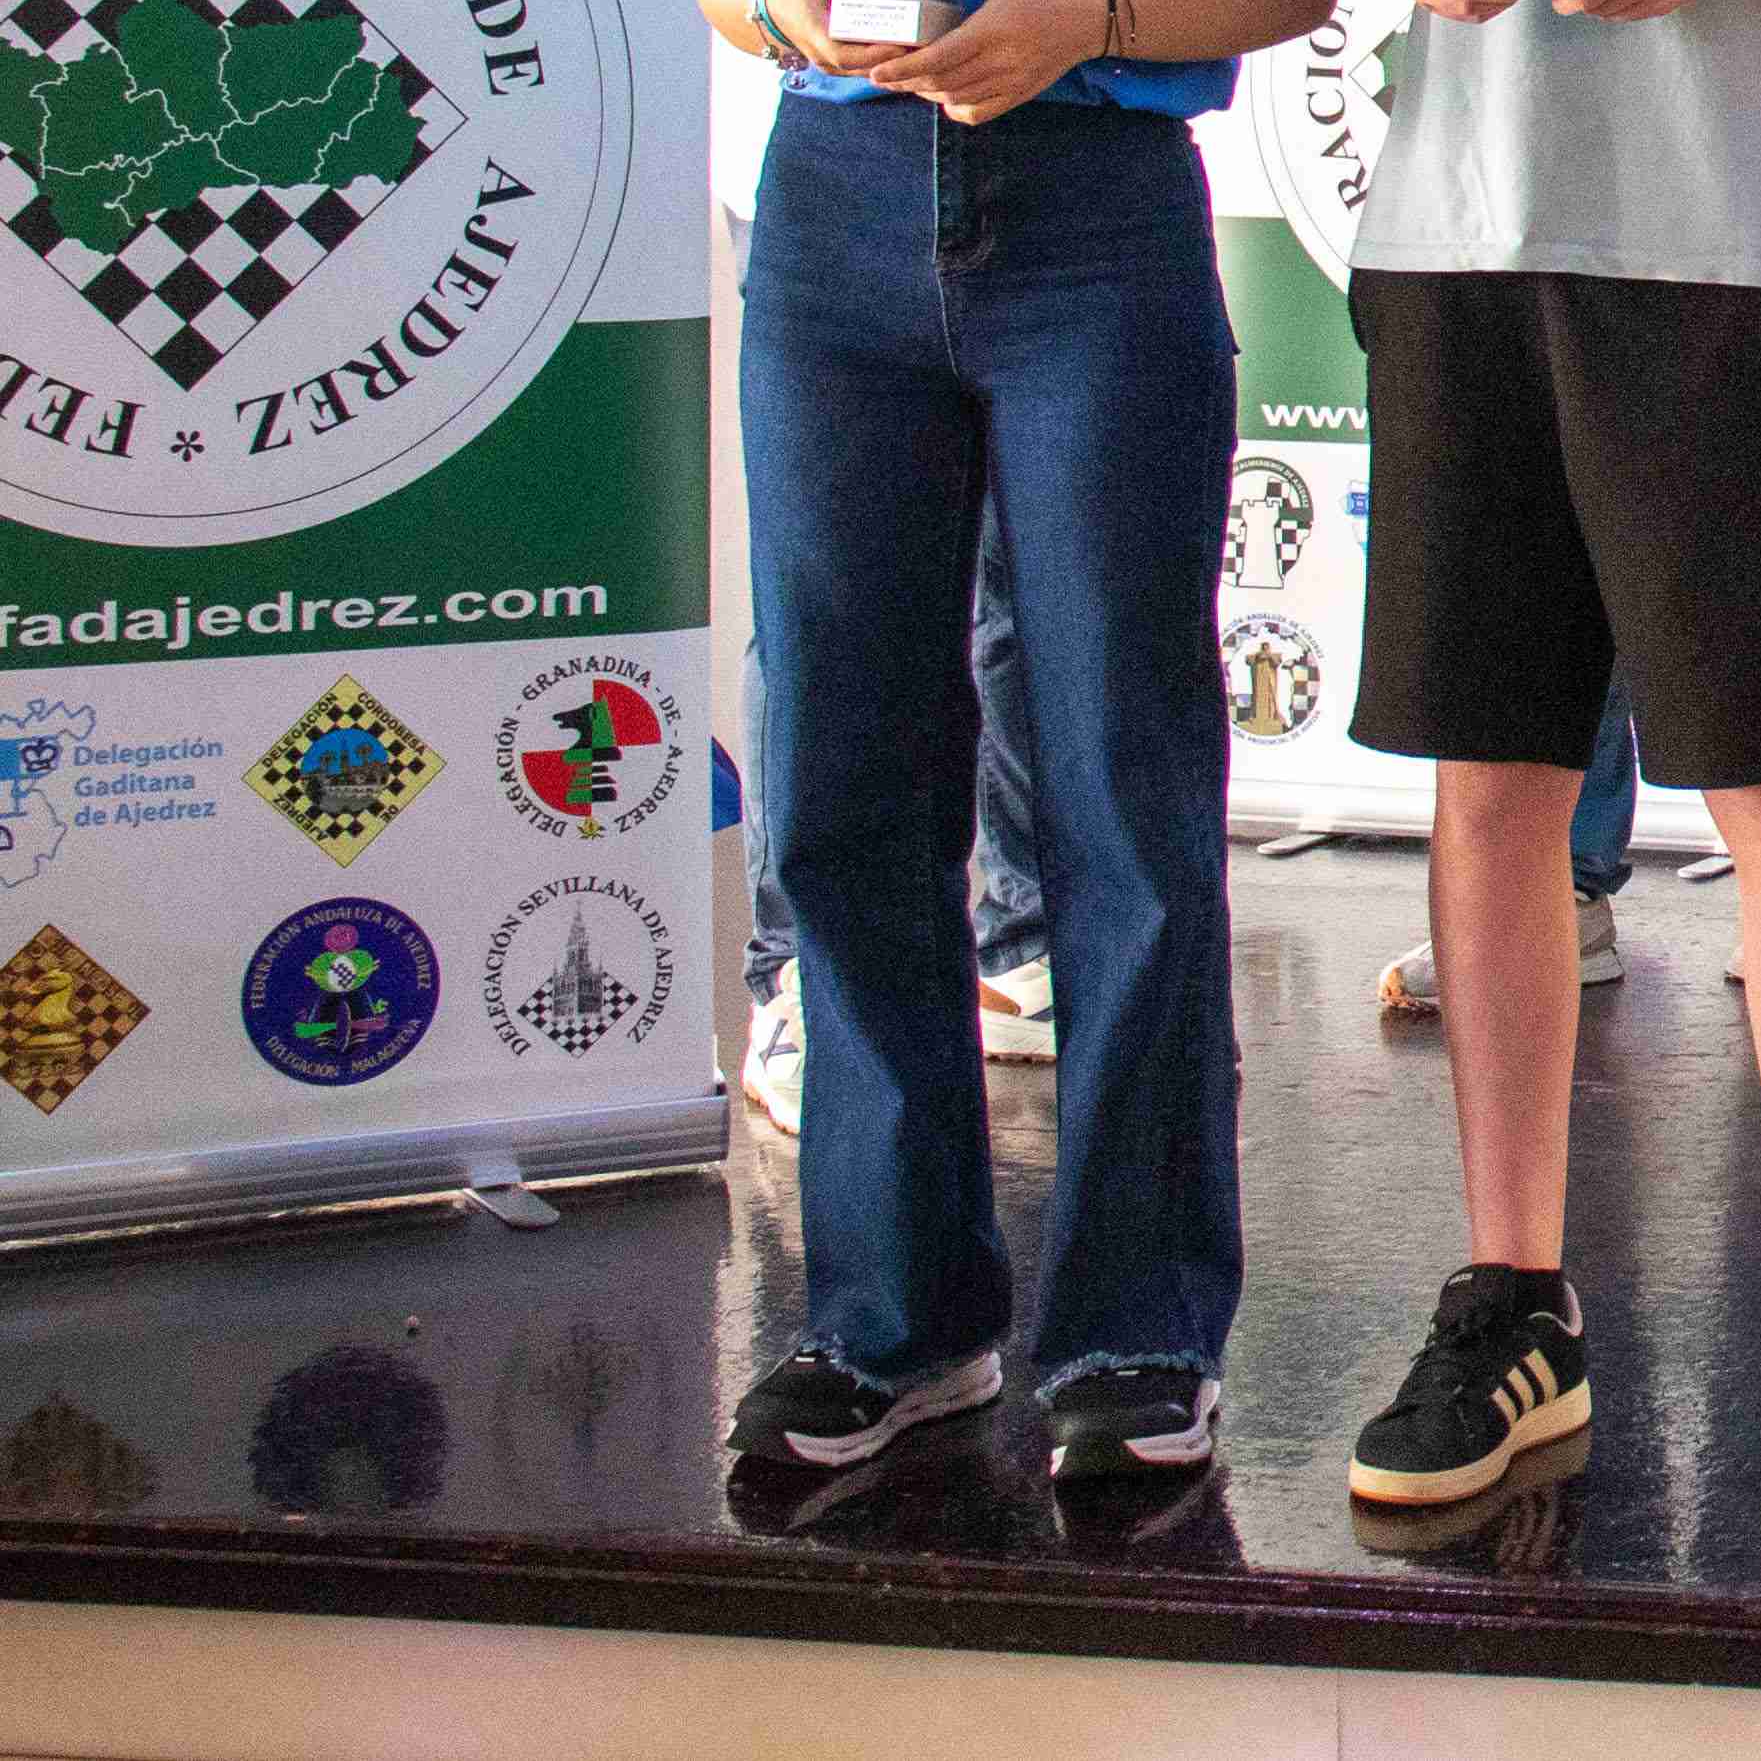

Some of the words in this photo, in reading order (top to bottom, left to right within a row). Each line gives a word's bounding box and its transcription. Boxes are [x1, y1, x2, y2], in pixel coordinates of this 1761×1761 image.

[236, 155, 537, 455] AJEDREZ
[0, 583, 608, 651] fadajedrez.com
[521, 655, 651, 699] GRANADINA
[658, 695, 681, 725] DE
[73, 737, 224, 767] Delegación
[74, 773, 196, 799] Gaditana
[496, 715, 569, 838] DELEGACIÓN
[615, 744, 684, 834] AJEDREZ
[74, 805, 107, 827] de
[114, 799, 217, 828] Ajedrez
[517, 875, 645, 917] SEVILLANA
[640, 909, 669, 943] DE
[483, 913, 531, 1057] DELEGACIÓN
[627, 945, 673, 1044] AJEDREZ
